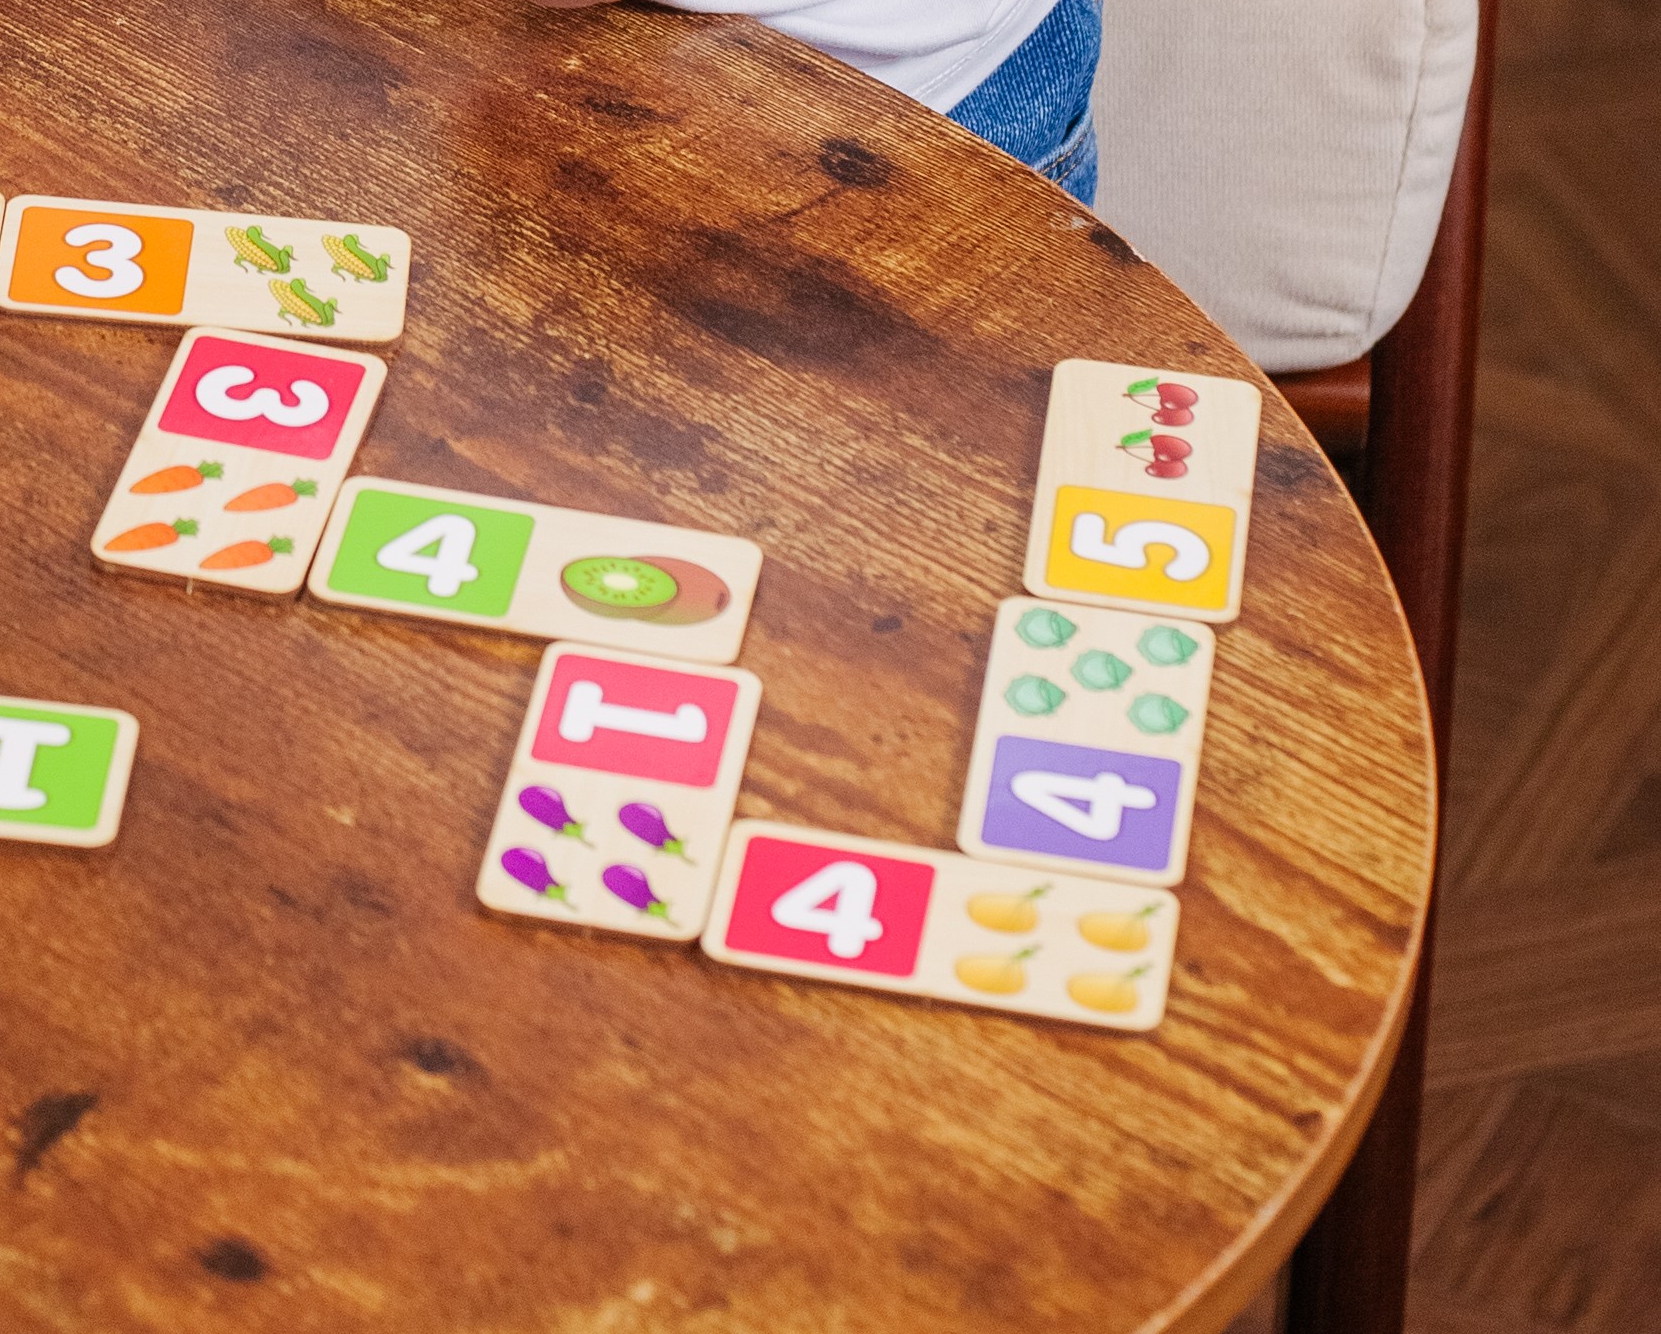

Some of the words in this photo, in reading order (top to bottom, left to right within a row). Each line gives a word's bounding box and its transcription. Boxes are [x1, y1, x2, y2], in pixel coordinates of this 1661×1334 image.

[54, 223, 144, 299] 3
[195, 365, 330, 427] 3
[375, 513, 479, 598] 4
[1070, 512, 1211, 581] 5
[558, 680, 708, 743] 1
[1010, 769, 1157, 841] 4
[771, 862, 883, 959] 4
